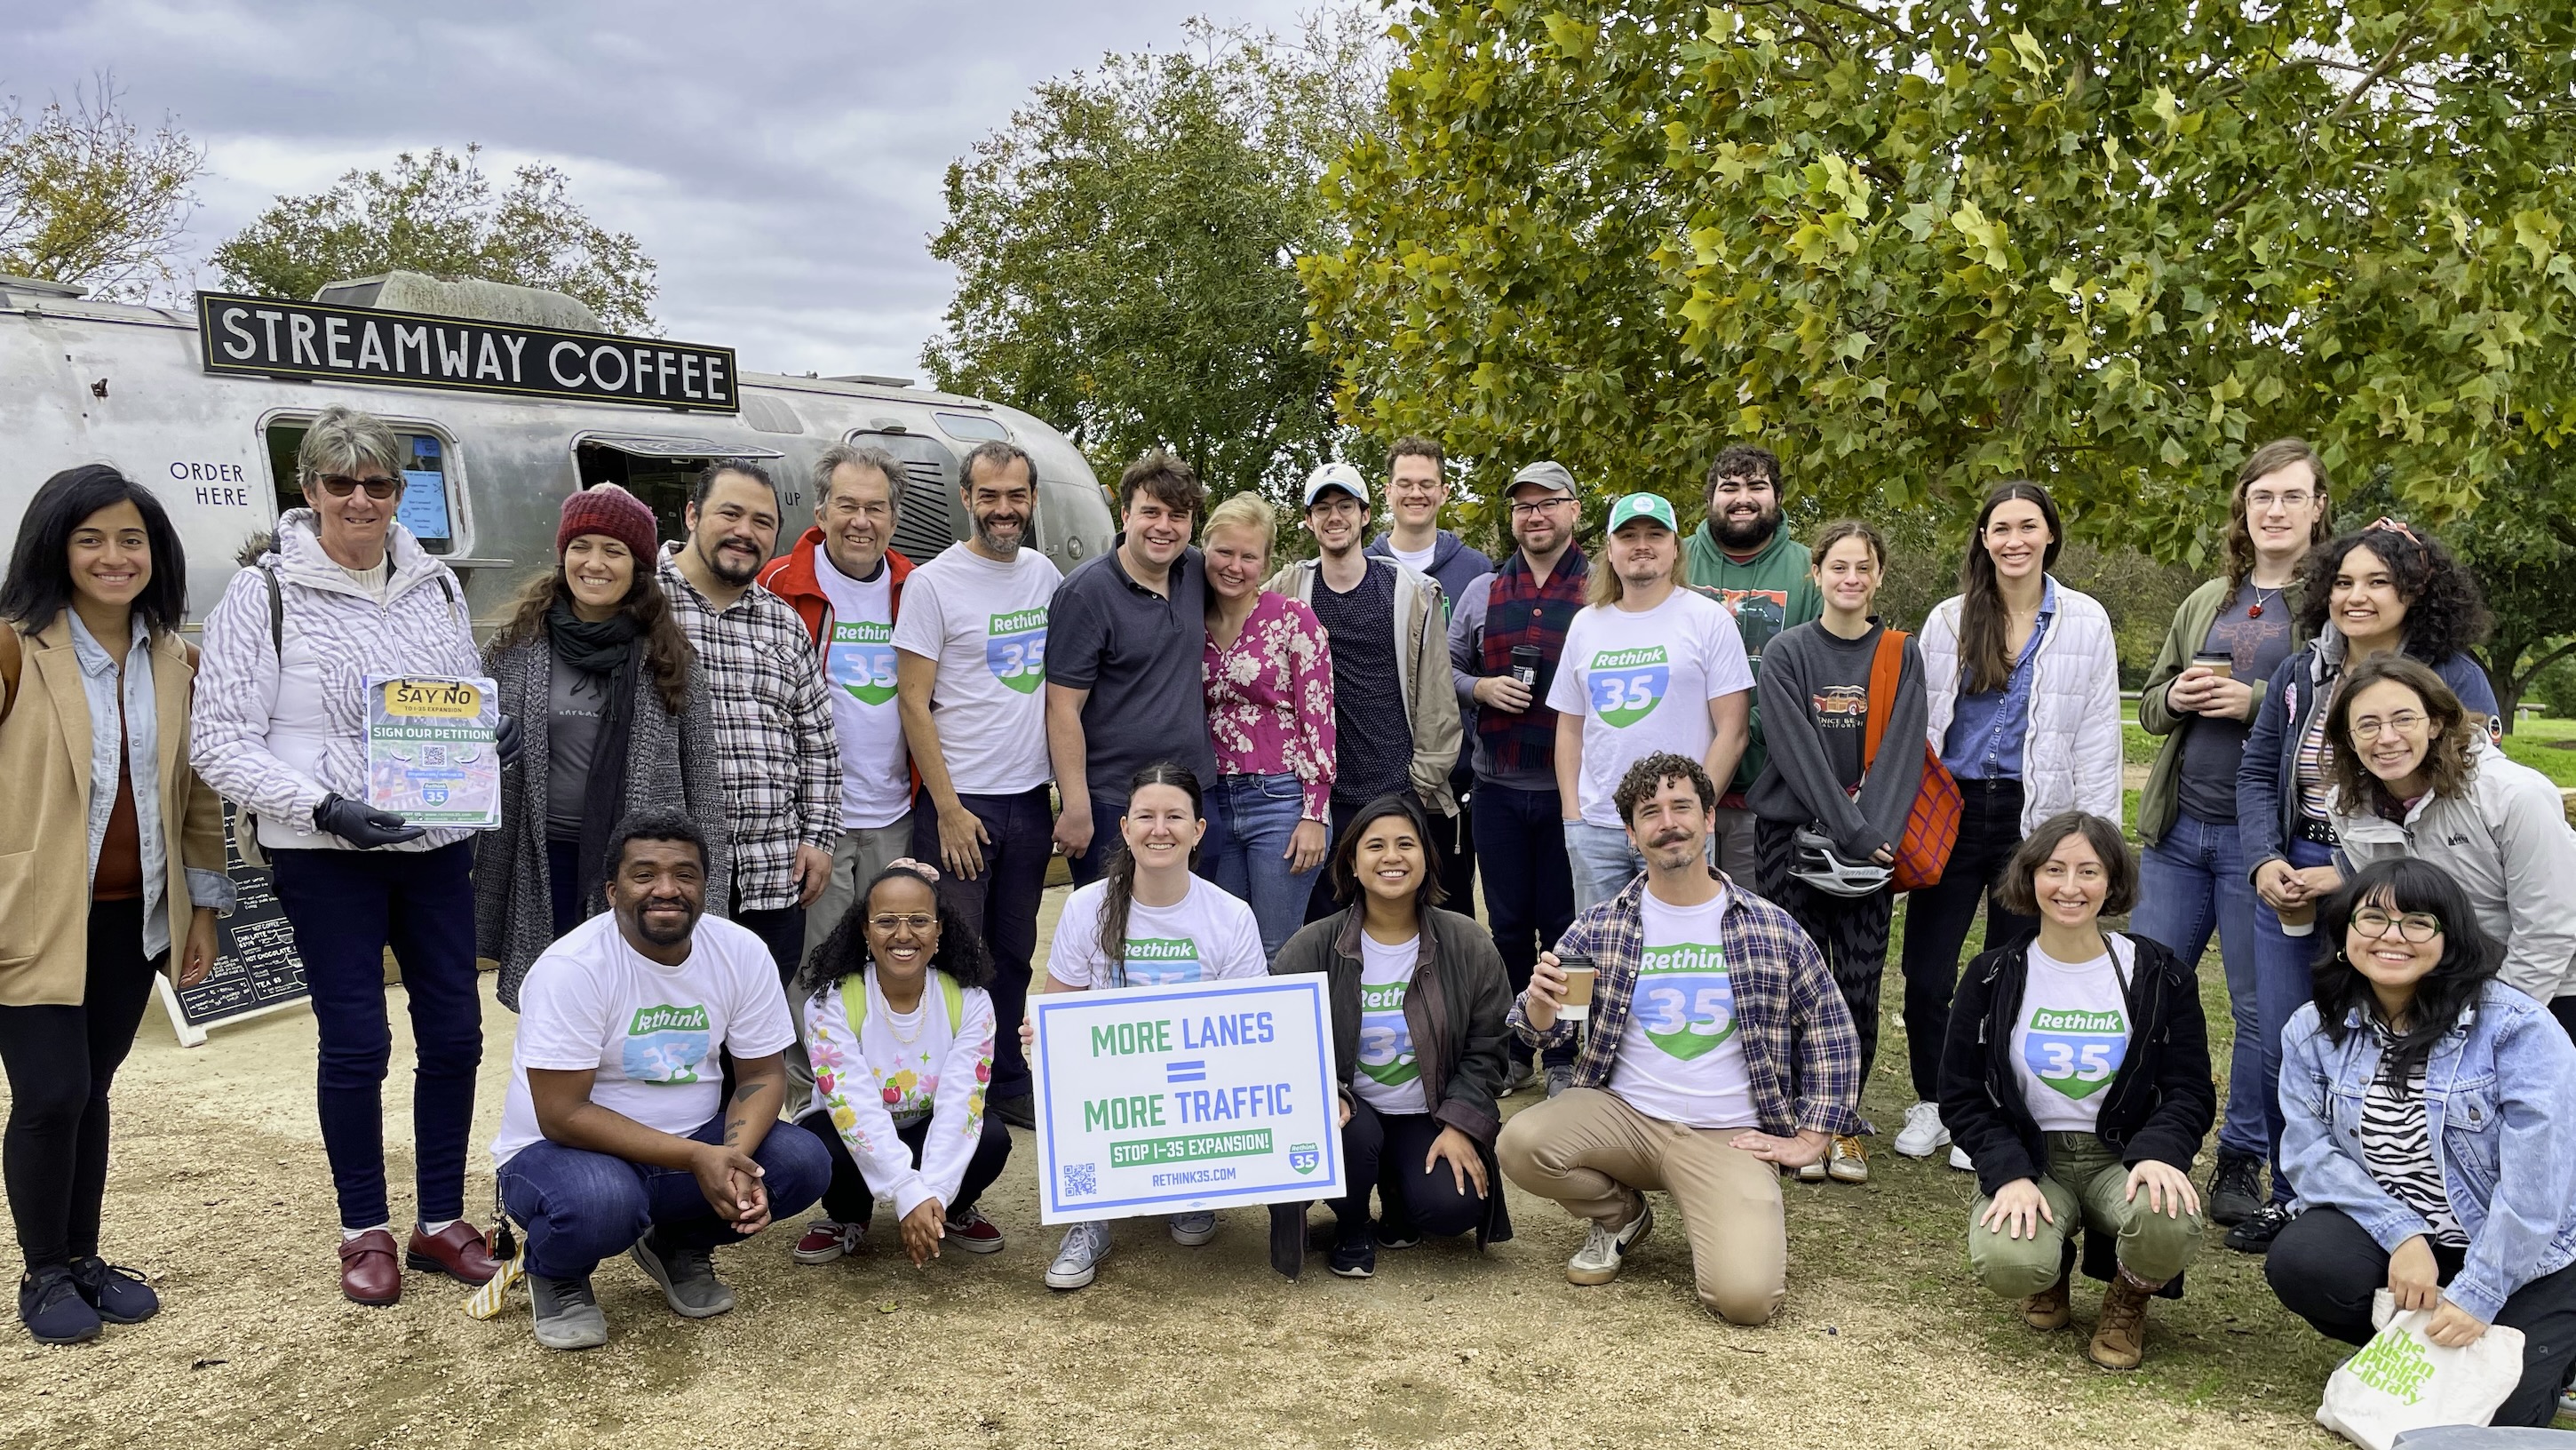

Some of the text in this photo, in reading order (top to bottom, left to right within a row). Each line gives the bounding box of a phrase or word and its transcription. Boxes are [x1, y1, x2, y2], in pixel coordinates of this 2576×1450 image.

[221, 307, 727, 402] STREAMWAY COFFEE
[170, 462, 245, 483] ORDER
[196, 487, 249, 507] HERE
[784, 491, 801, 506] UP
[1596, 648, 1665, 668] Rethink
[844, 653, 899, 689] 35
[397, 689, 471, 705] SAY NO
[1600, 674, 1653, 713] 35
[373, 727, 494, 740] SIGN OUR PETITION!
[425, 791, 445, 802] 35
[261, 920, 280, 929] COFFEE
[250, 931, 267, 940] LATTE
[257, 946, 292, 960] CHOCOLATE
[1123, 942, 1193, 958] Rethink
[1640, 948, 1728, 971] Rethin
[255, 980, 272, 989] TEA
[1649, 987, 1731, 1036] 35
[2037, 1013, 2119, 1031] Rethink
[1091, 1011, 1275, 1057] MORE LANES
[642, 1042, 690, 1082] 35
[2040, 1042, 2111, 1082] 35
[1084, 1083, 1293, 1133] MORE TRAFFIC
[1113, 1133, 1270, 1163] STOP I-35 EXPANSION!
[1294, 1153, 1316, 1169] 35
[1152, 1167, 1236, 1187] RETHINK35.COM
[2389, 1326, 2426, 1357] The
[2366, 1332, 2436, 1380] Austin
[2358, 1347, 2427, 1389] Public
[2346, 1352, 2426, 1406] Library
